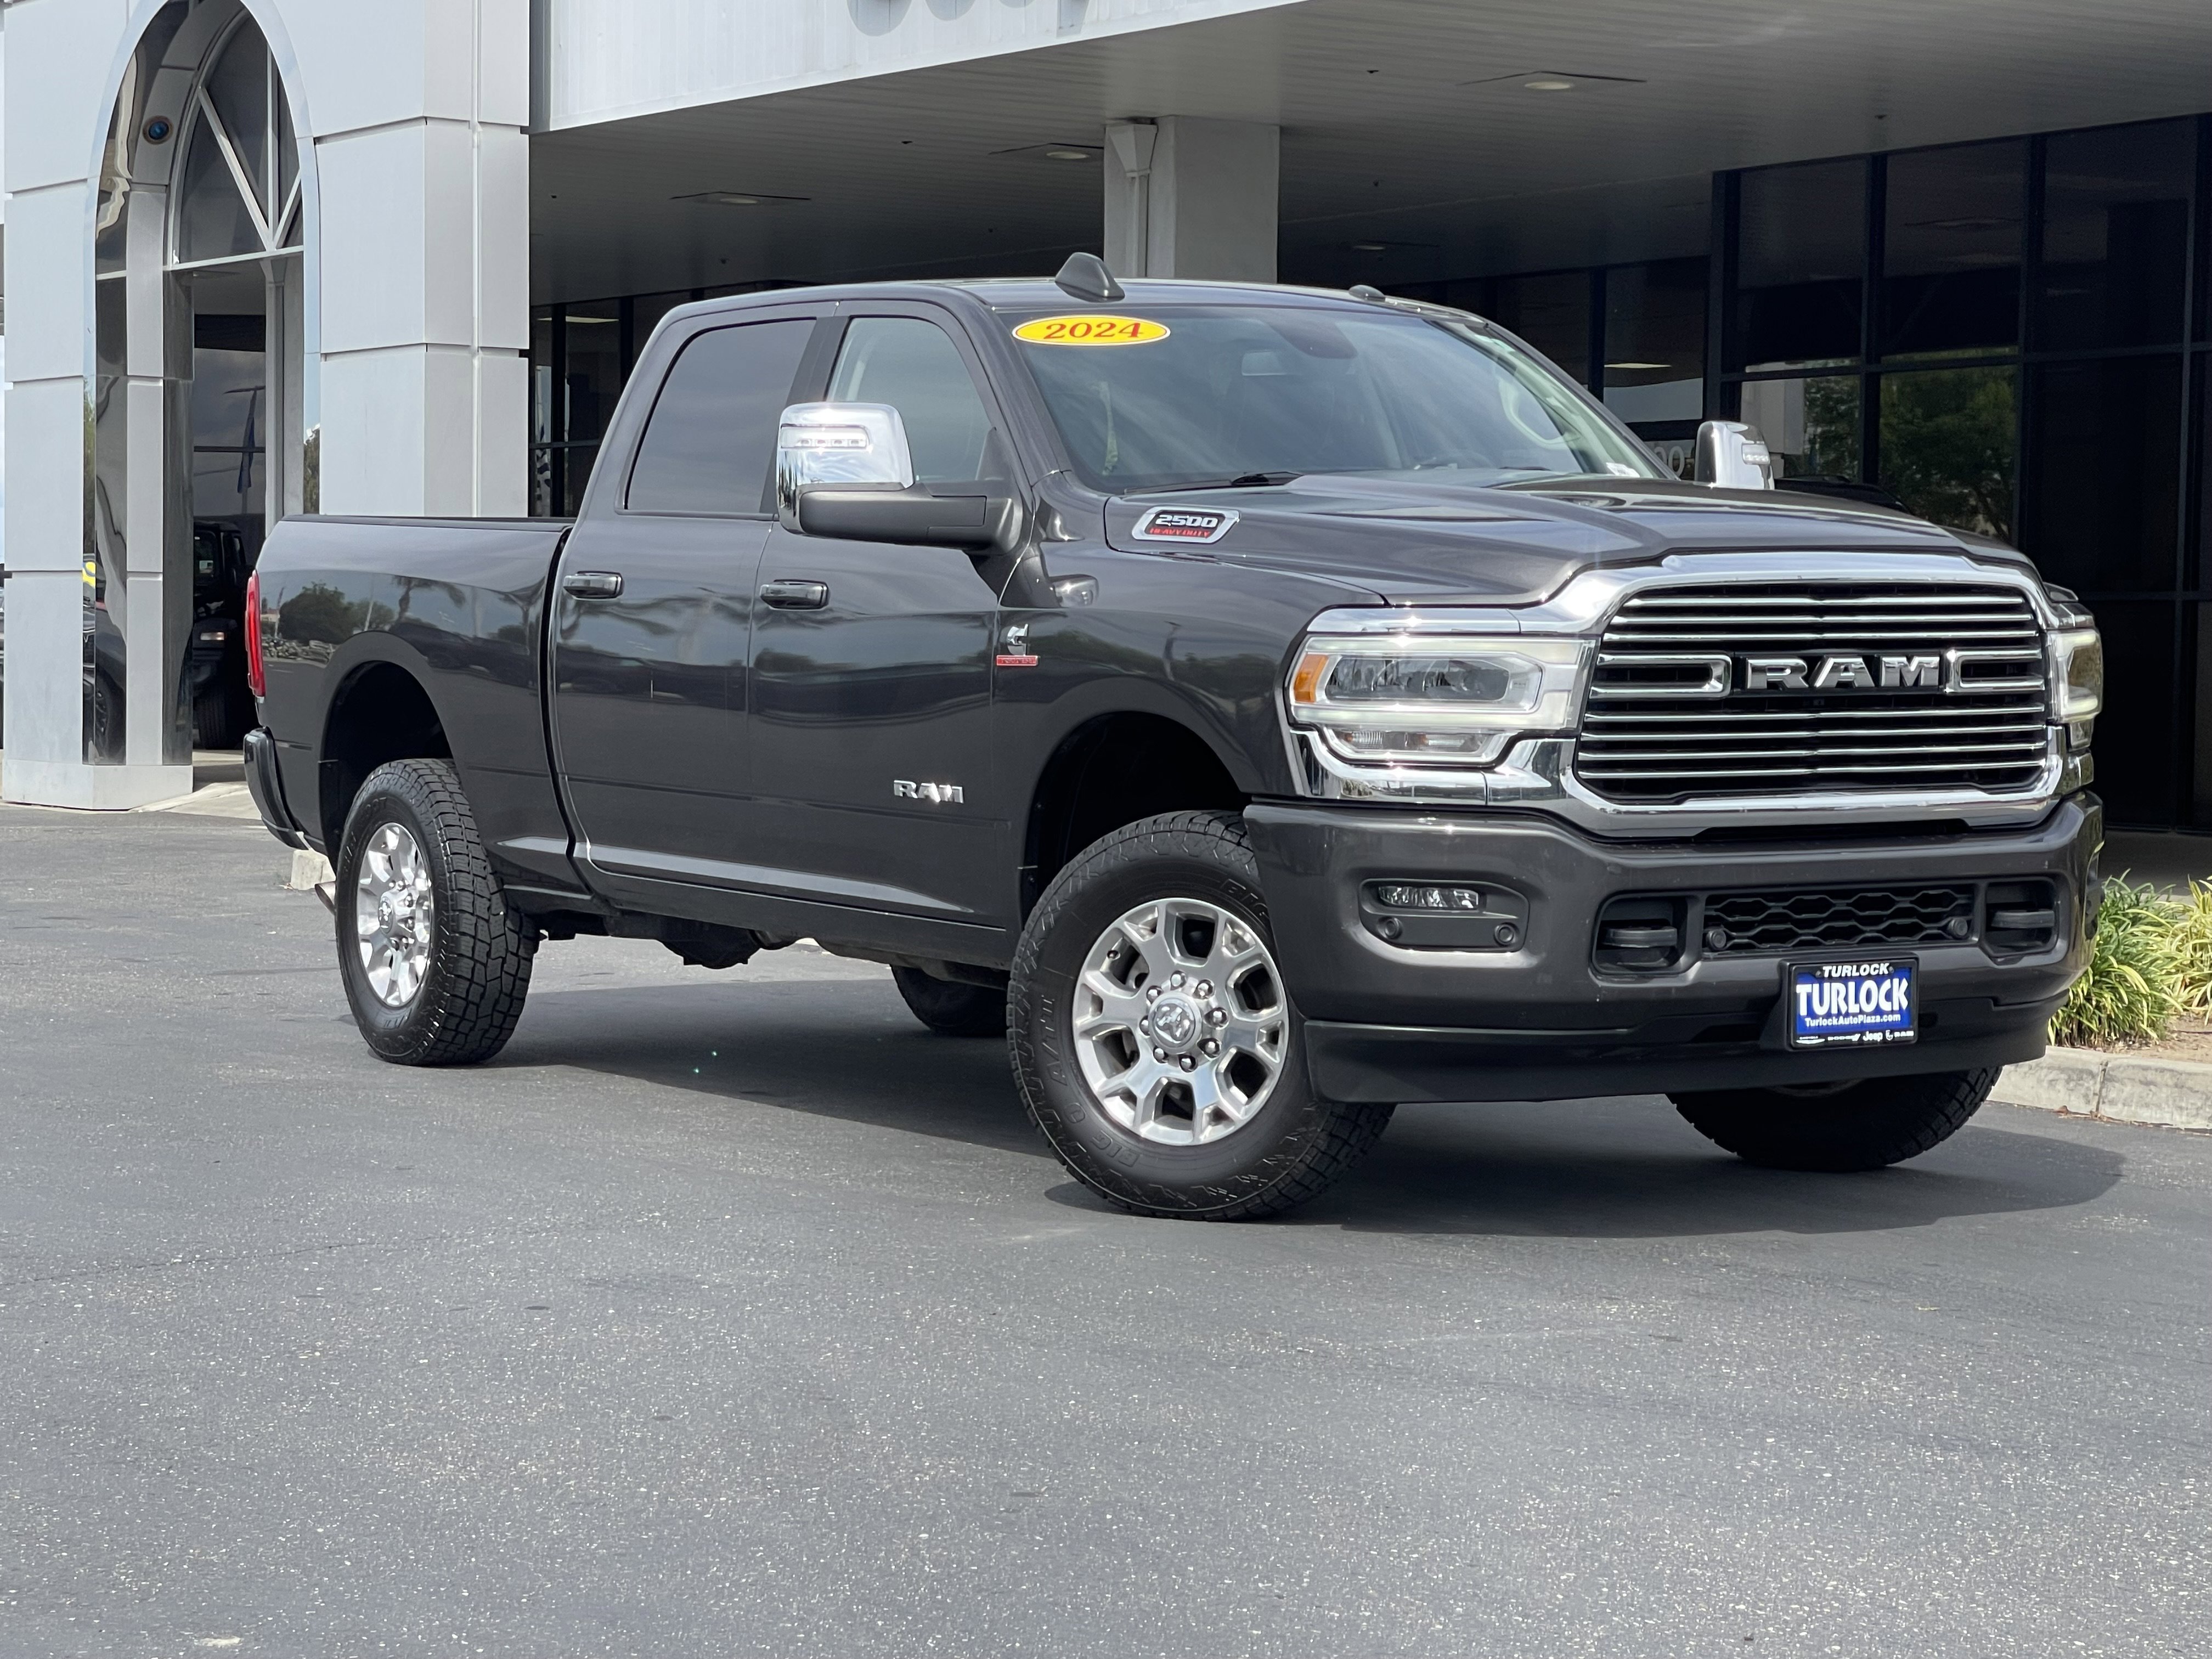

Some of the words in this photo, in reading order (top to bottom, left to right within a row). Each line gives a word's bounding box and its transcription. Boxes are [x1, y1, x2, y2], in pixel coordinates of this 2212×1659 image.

[1043, 322, 1144, 339] 2024
[1155, 515, 1218, 528] 2500
[1746, 656, 1940, 689] RAM
[894, 780, 964, 804] RAM
[1822, 963, 1889, 978] TURLOCK
[1796, 978, 1908, 1015] TURLOCK
[1805, 1014, 1901, 1027] TurlockAutoPlaza.com
[1863, 1031, 1883, 1042] Jeep
